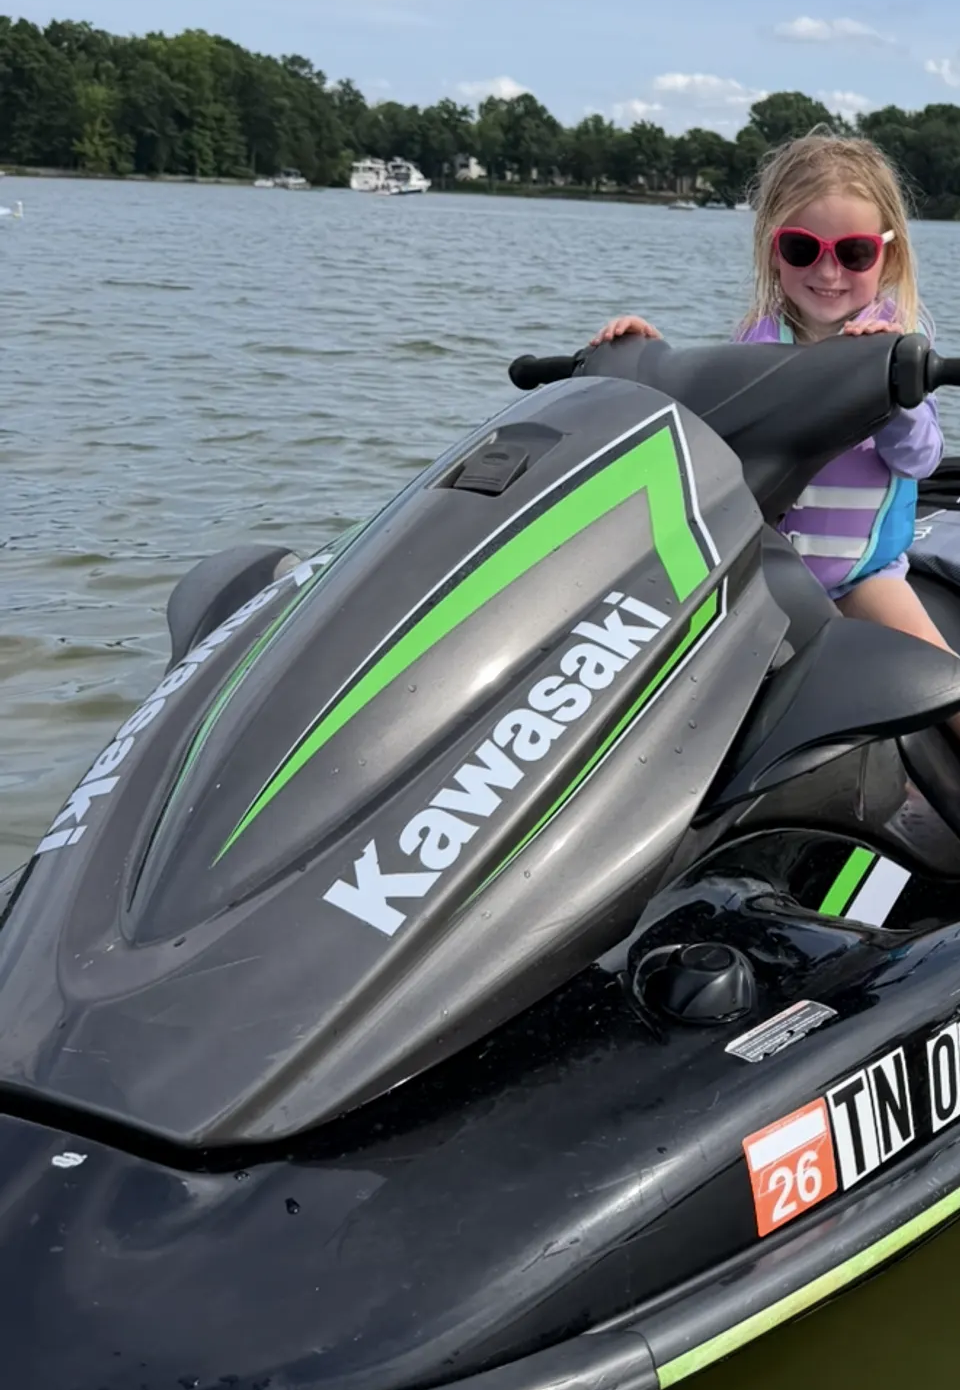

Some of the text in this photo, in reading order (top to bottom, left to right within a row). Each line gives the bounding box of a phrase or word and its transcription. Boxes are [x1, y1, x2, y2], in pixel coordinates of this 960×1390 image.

[322, 591, 672, 937] Kawasaki
[831, 1059, 913, 1177] TN
[768, 1150, 822, 1222] 26
